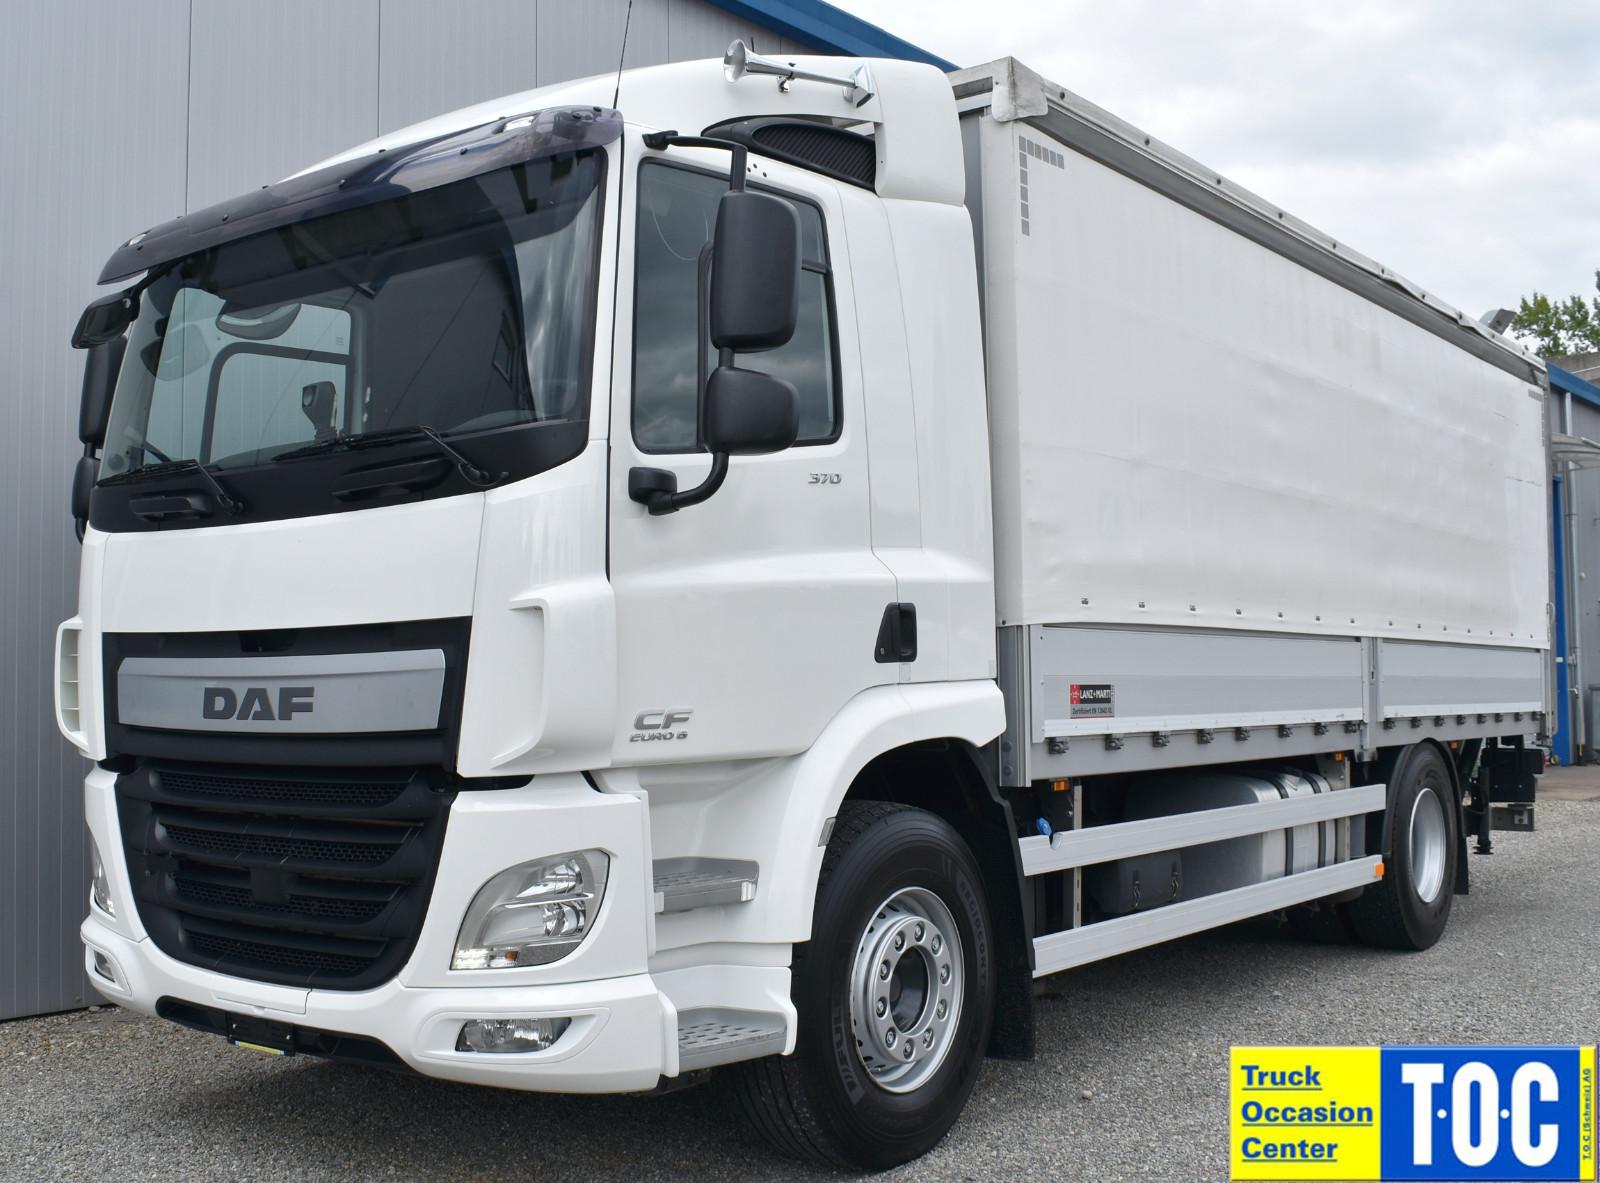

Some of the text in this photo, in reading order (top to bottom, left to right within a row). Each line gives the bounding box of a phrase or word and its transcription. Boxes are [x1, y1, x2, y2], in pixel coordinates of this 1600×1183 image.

[808, 473, 842, 484] 370
[203, 687, 314, 720] DAF
[634, 710, 692, 730] CF
[629, 731, 688, 742] EURO 6
